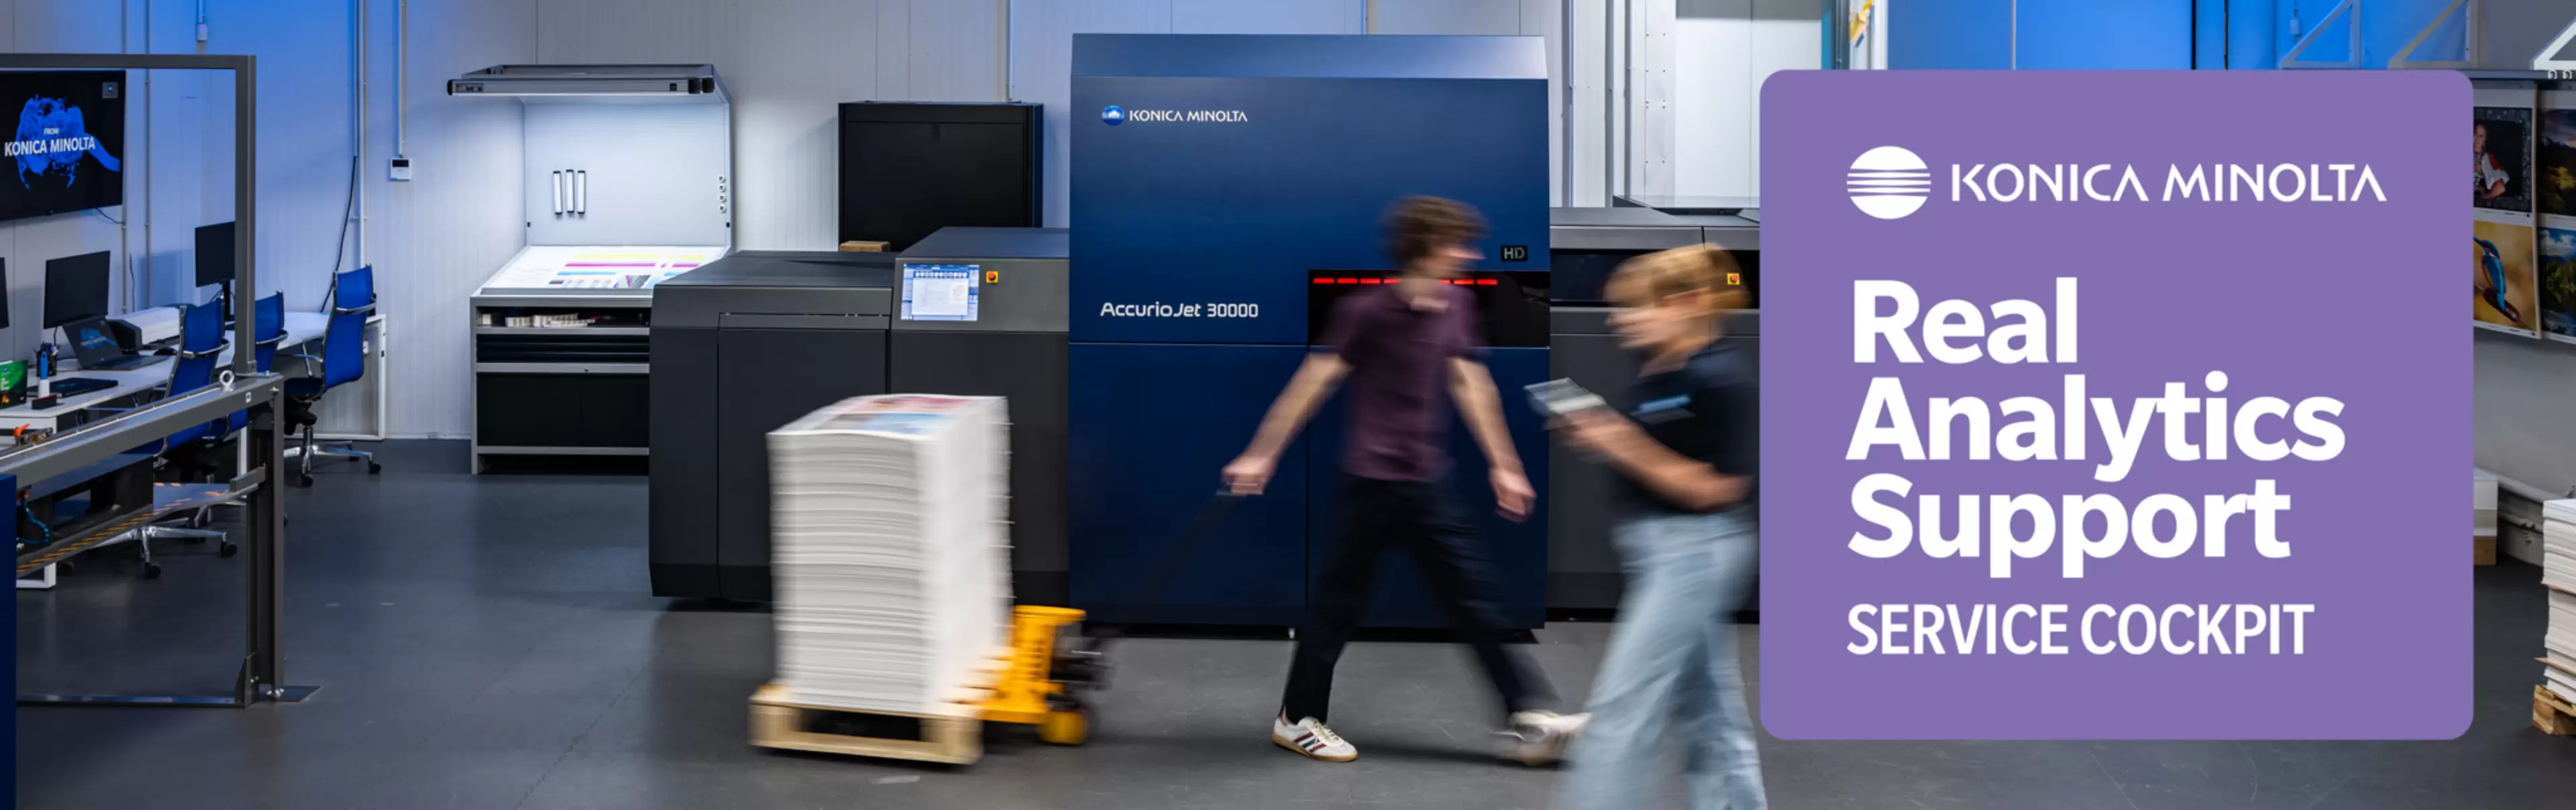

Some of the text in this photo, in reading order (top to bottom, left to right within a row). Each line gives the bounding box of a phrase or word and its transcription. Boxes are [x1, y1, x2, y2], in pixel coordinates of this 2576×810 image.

[1129, 109, 1248, 123] KONICA MINOLTA
[4, 136, 96, 157] KONICA MINOLTA
[1504, 247, 1525, 259] HD
[1207, 303, 1258, 317] 30000
